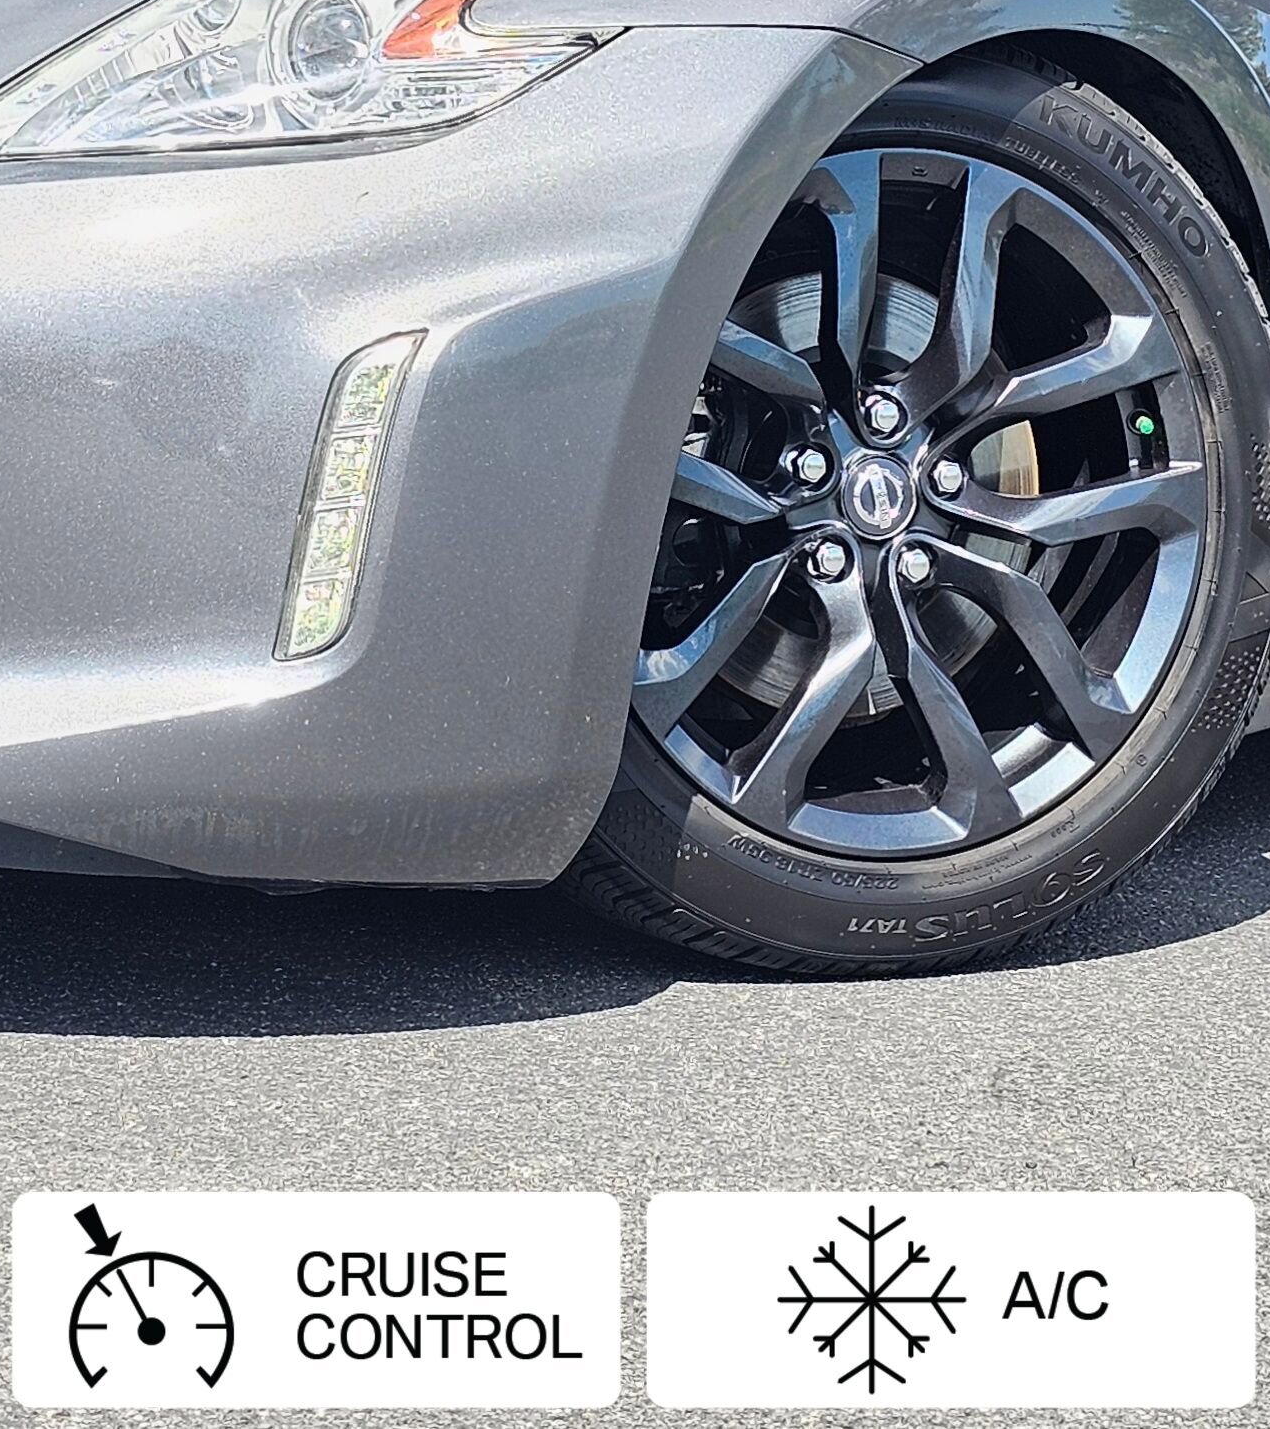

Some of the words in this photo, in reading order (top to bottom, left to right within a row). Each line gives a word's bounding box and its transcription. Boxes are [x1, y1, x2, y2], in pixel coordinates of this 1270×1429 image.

[1038, 95, 1212, 258] KUMHO
[846, 917, 908, 934] TA71
[914, 851, 1106, 942] SOLUS
